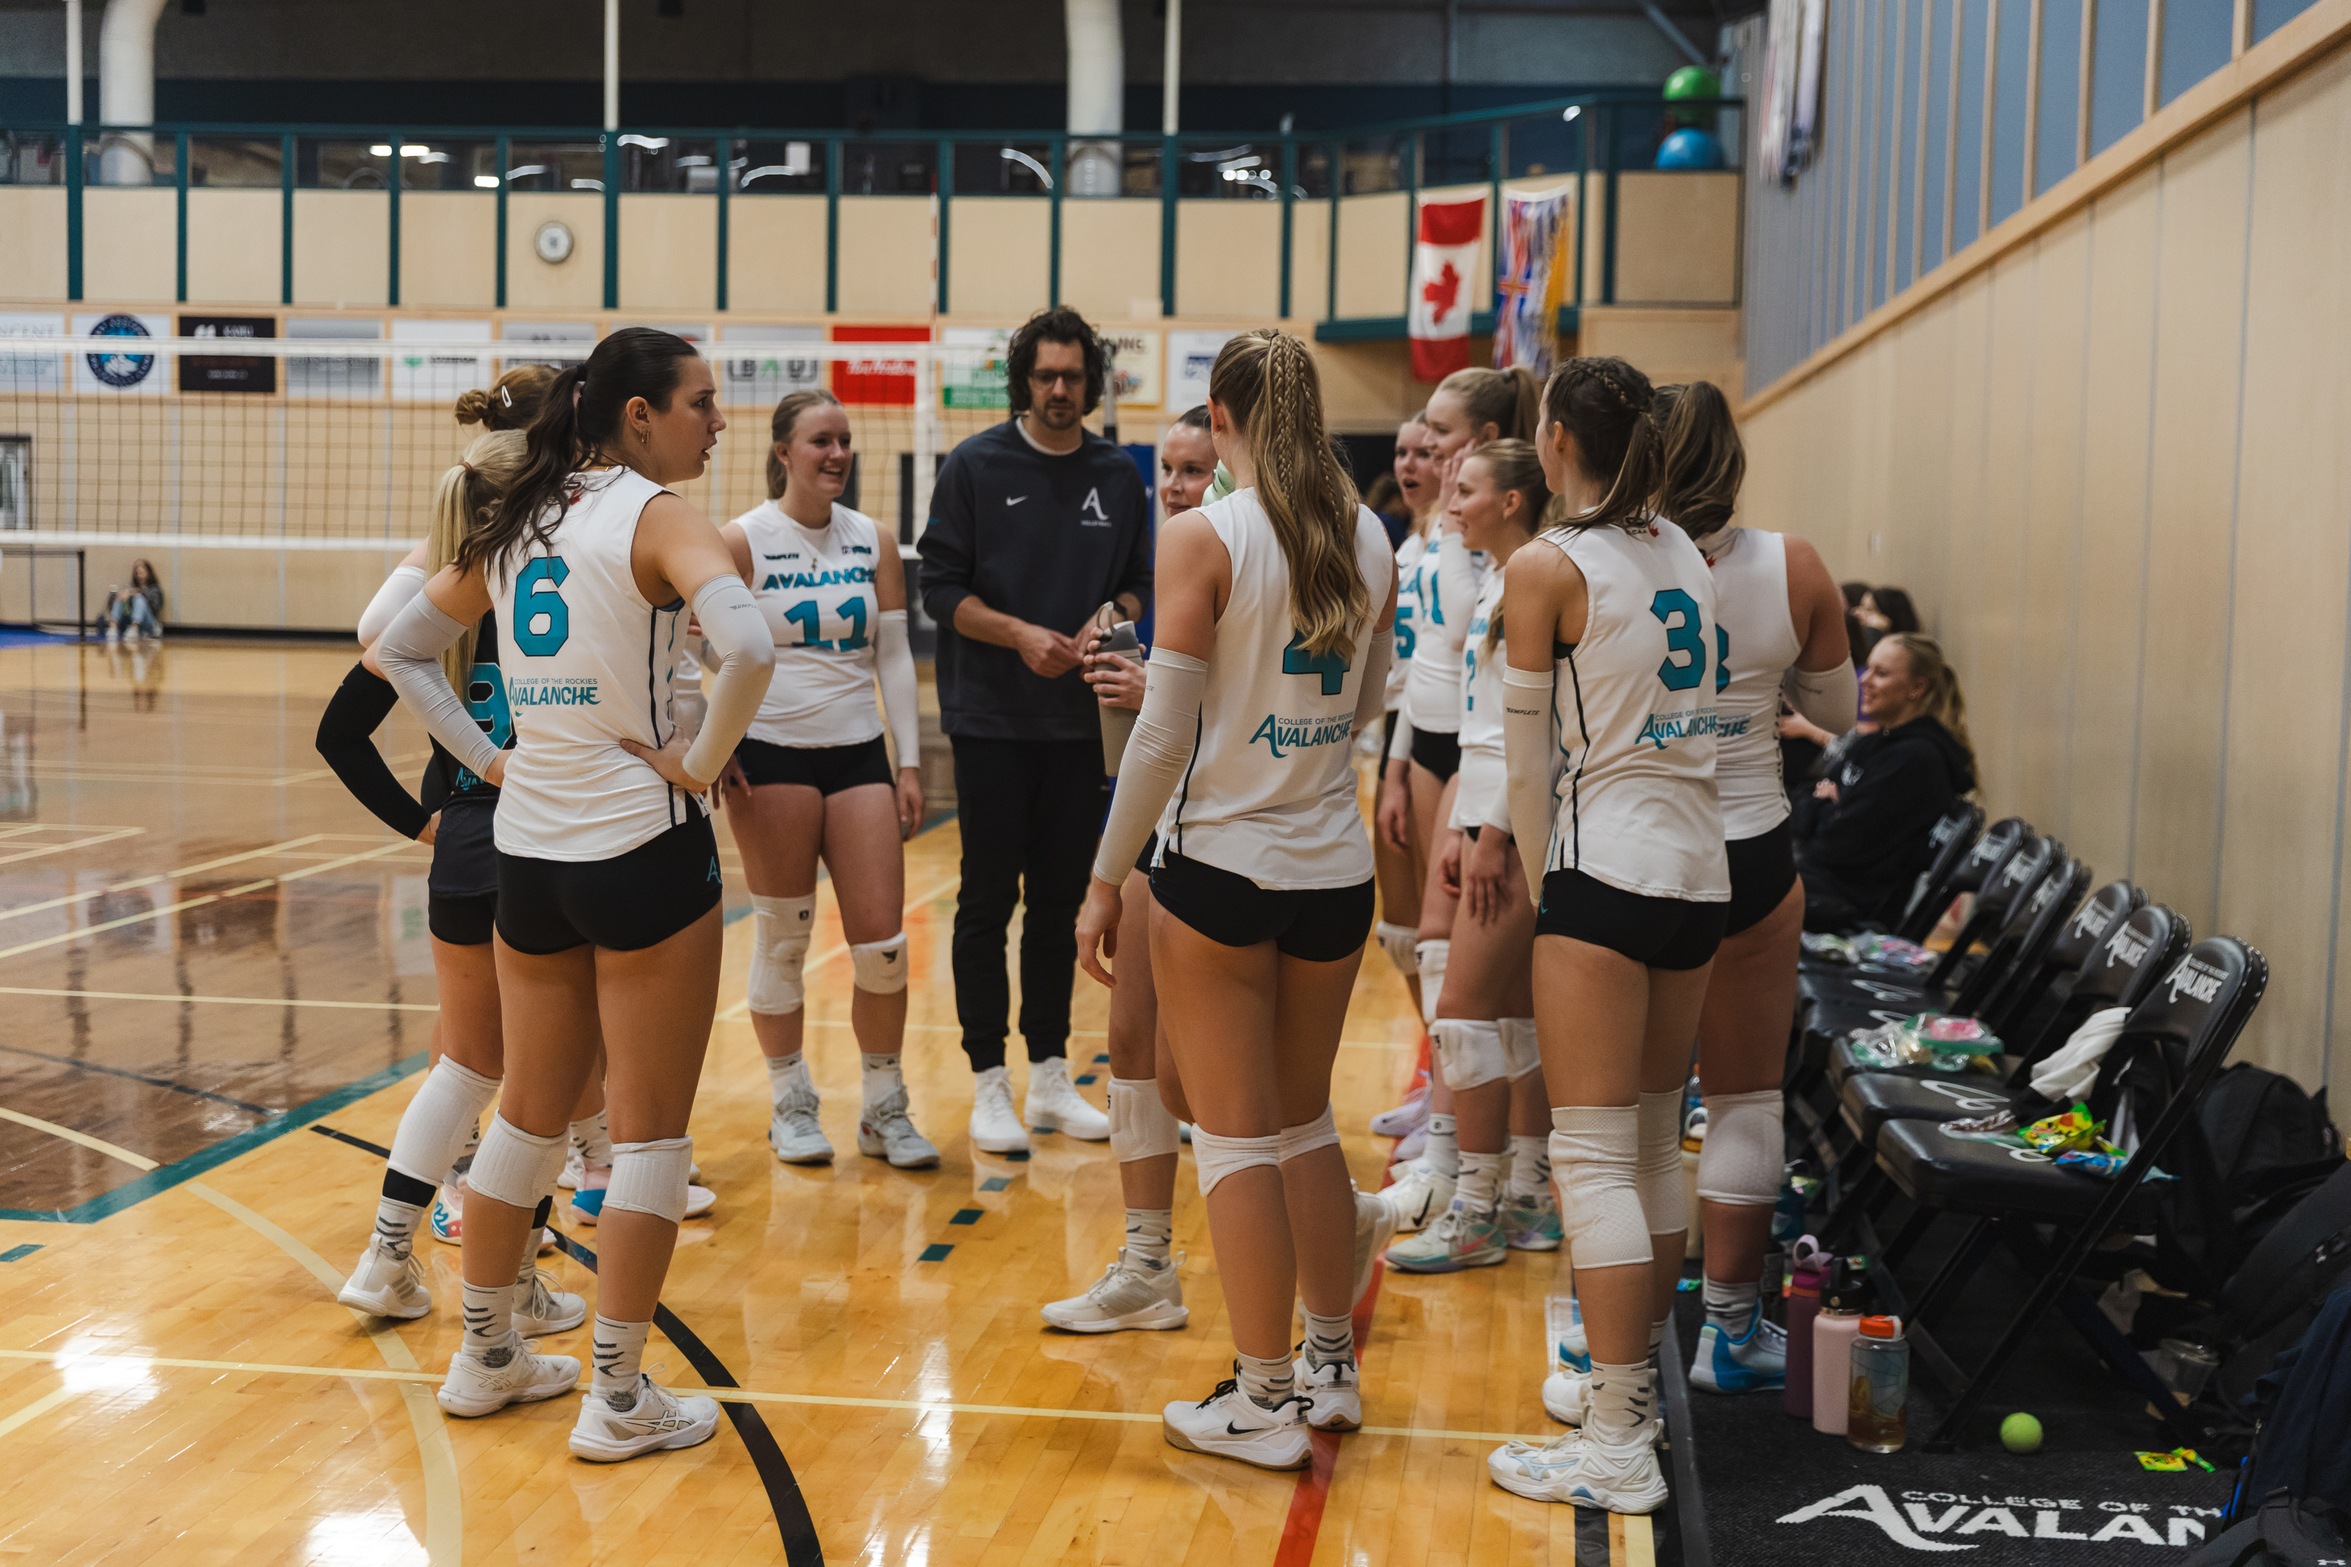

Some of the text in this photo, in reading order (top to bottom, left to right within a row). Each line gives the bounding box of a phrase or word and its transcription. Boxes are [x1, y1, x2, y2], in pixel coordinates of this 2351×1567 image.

[514, 556, 570, 656] 6
[784, 597, 869, 652] 11
[1282, 628, 1352, 695] 4
[1650, 588, 1706, 691] 3
[466, 662, 512, 750] 9
[509, 677, 602, 717] AVALANCHE
[1278, 717, 1312, 725] COLLEGE
[1315, 717, 1326, 725] OF
[1327, 715, 1337, 723] THE
[1655, 711, 1683, 721] COLLEGE
[1249, 714, 1353, 758] AVALANCHE
[1901, 1491, 2084, 1511] COLLEGE
[2098, 1501, 2151, 1513] OF
